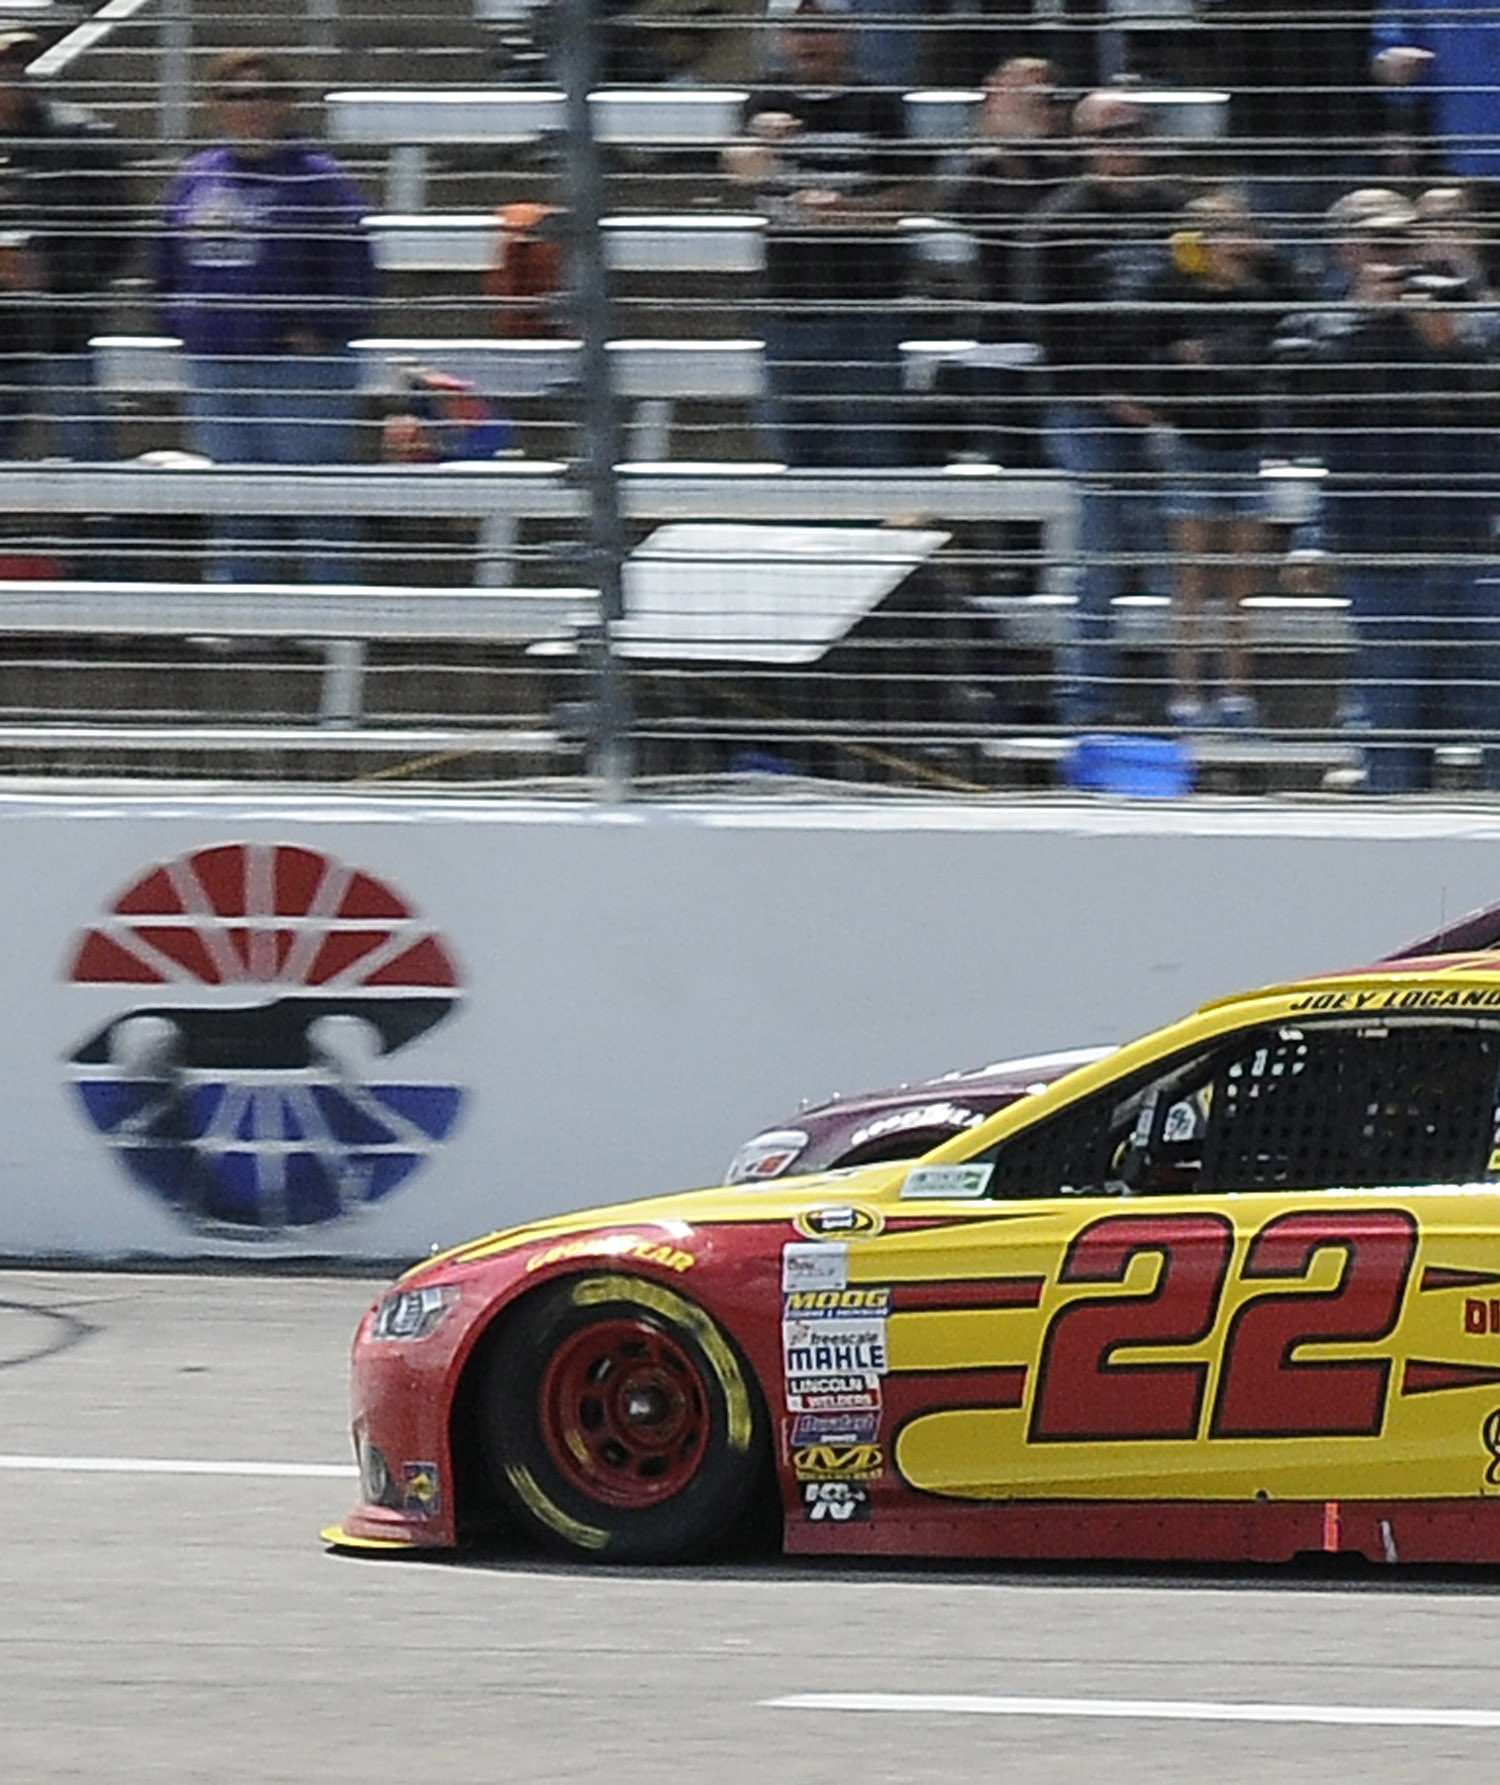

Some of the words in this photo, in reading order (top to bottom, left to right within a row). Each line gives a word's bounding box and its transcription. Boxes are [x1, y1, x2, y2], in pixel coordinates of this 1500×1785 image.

[1290, 991, 1375, 1011] JOEY
[788, 1290, 889, 1308] MOOG
[1028, 1208, 1418, 1442] 22
[810, 1330, 879, 1346] freescale
[788, 1345, 885, 1371] MAHLE
[790, 1378, 863, 1394] LINCOLN
[806, 1394, 872, 1407] WELDERS
